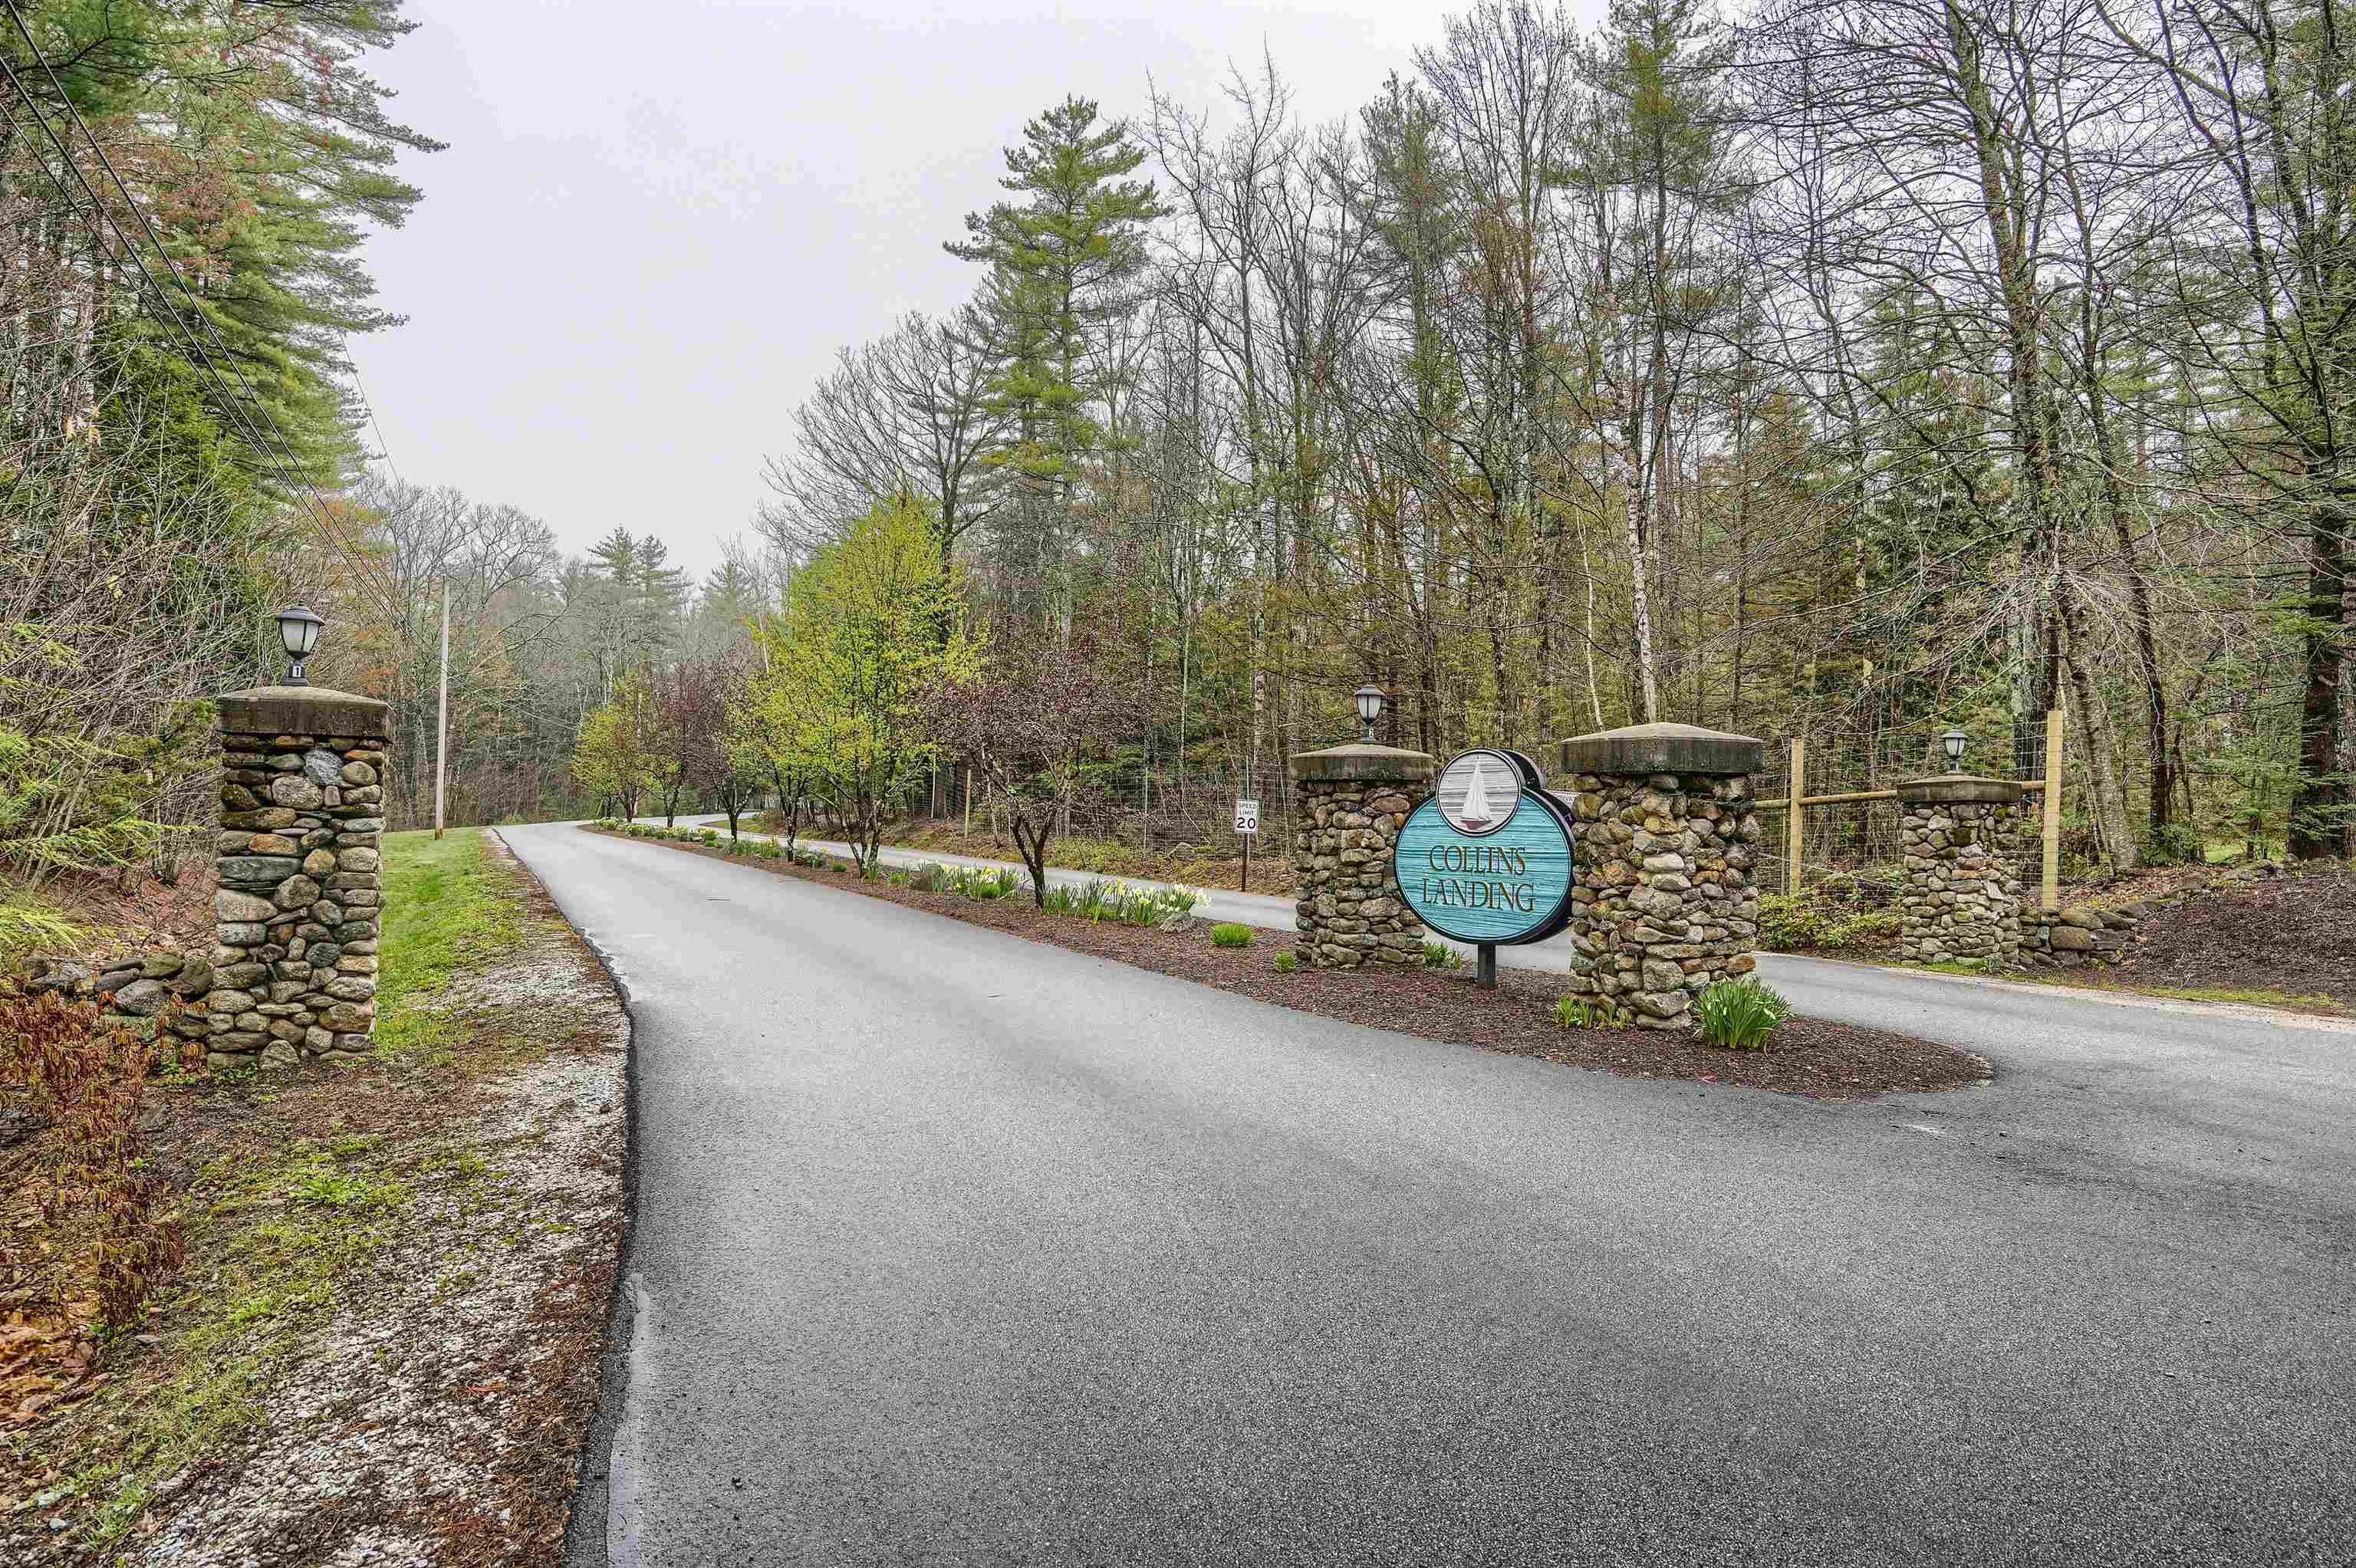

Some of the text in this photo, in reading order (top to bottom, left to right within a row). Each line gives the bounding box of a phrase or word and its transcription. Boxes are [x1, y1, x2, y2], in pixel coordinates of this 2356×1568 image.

[1237, 817, 1255, 829] 20
[1429, 844, 1526, 876] COLLINS
[1422, 878, 1535, 912] LANDING
